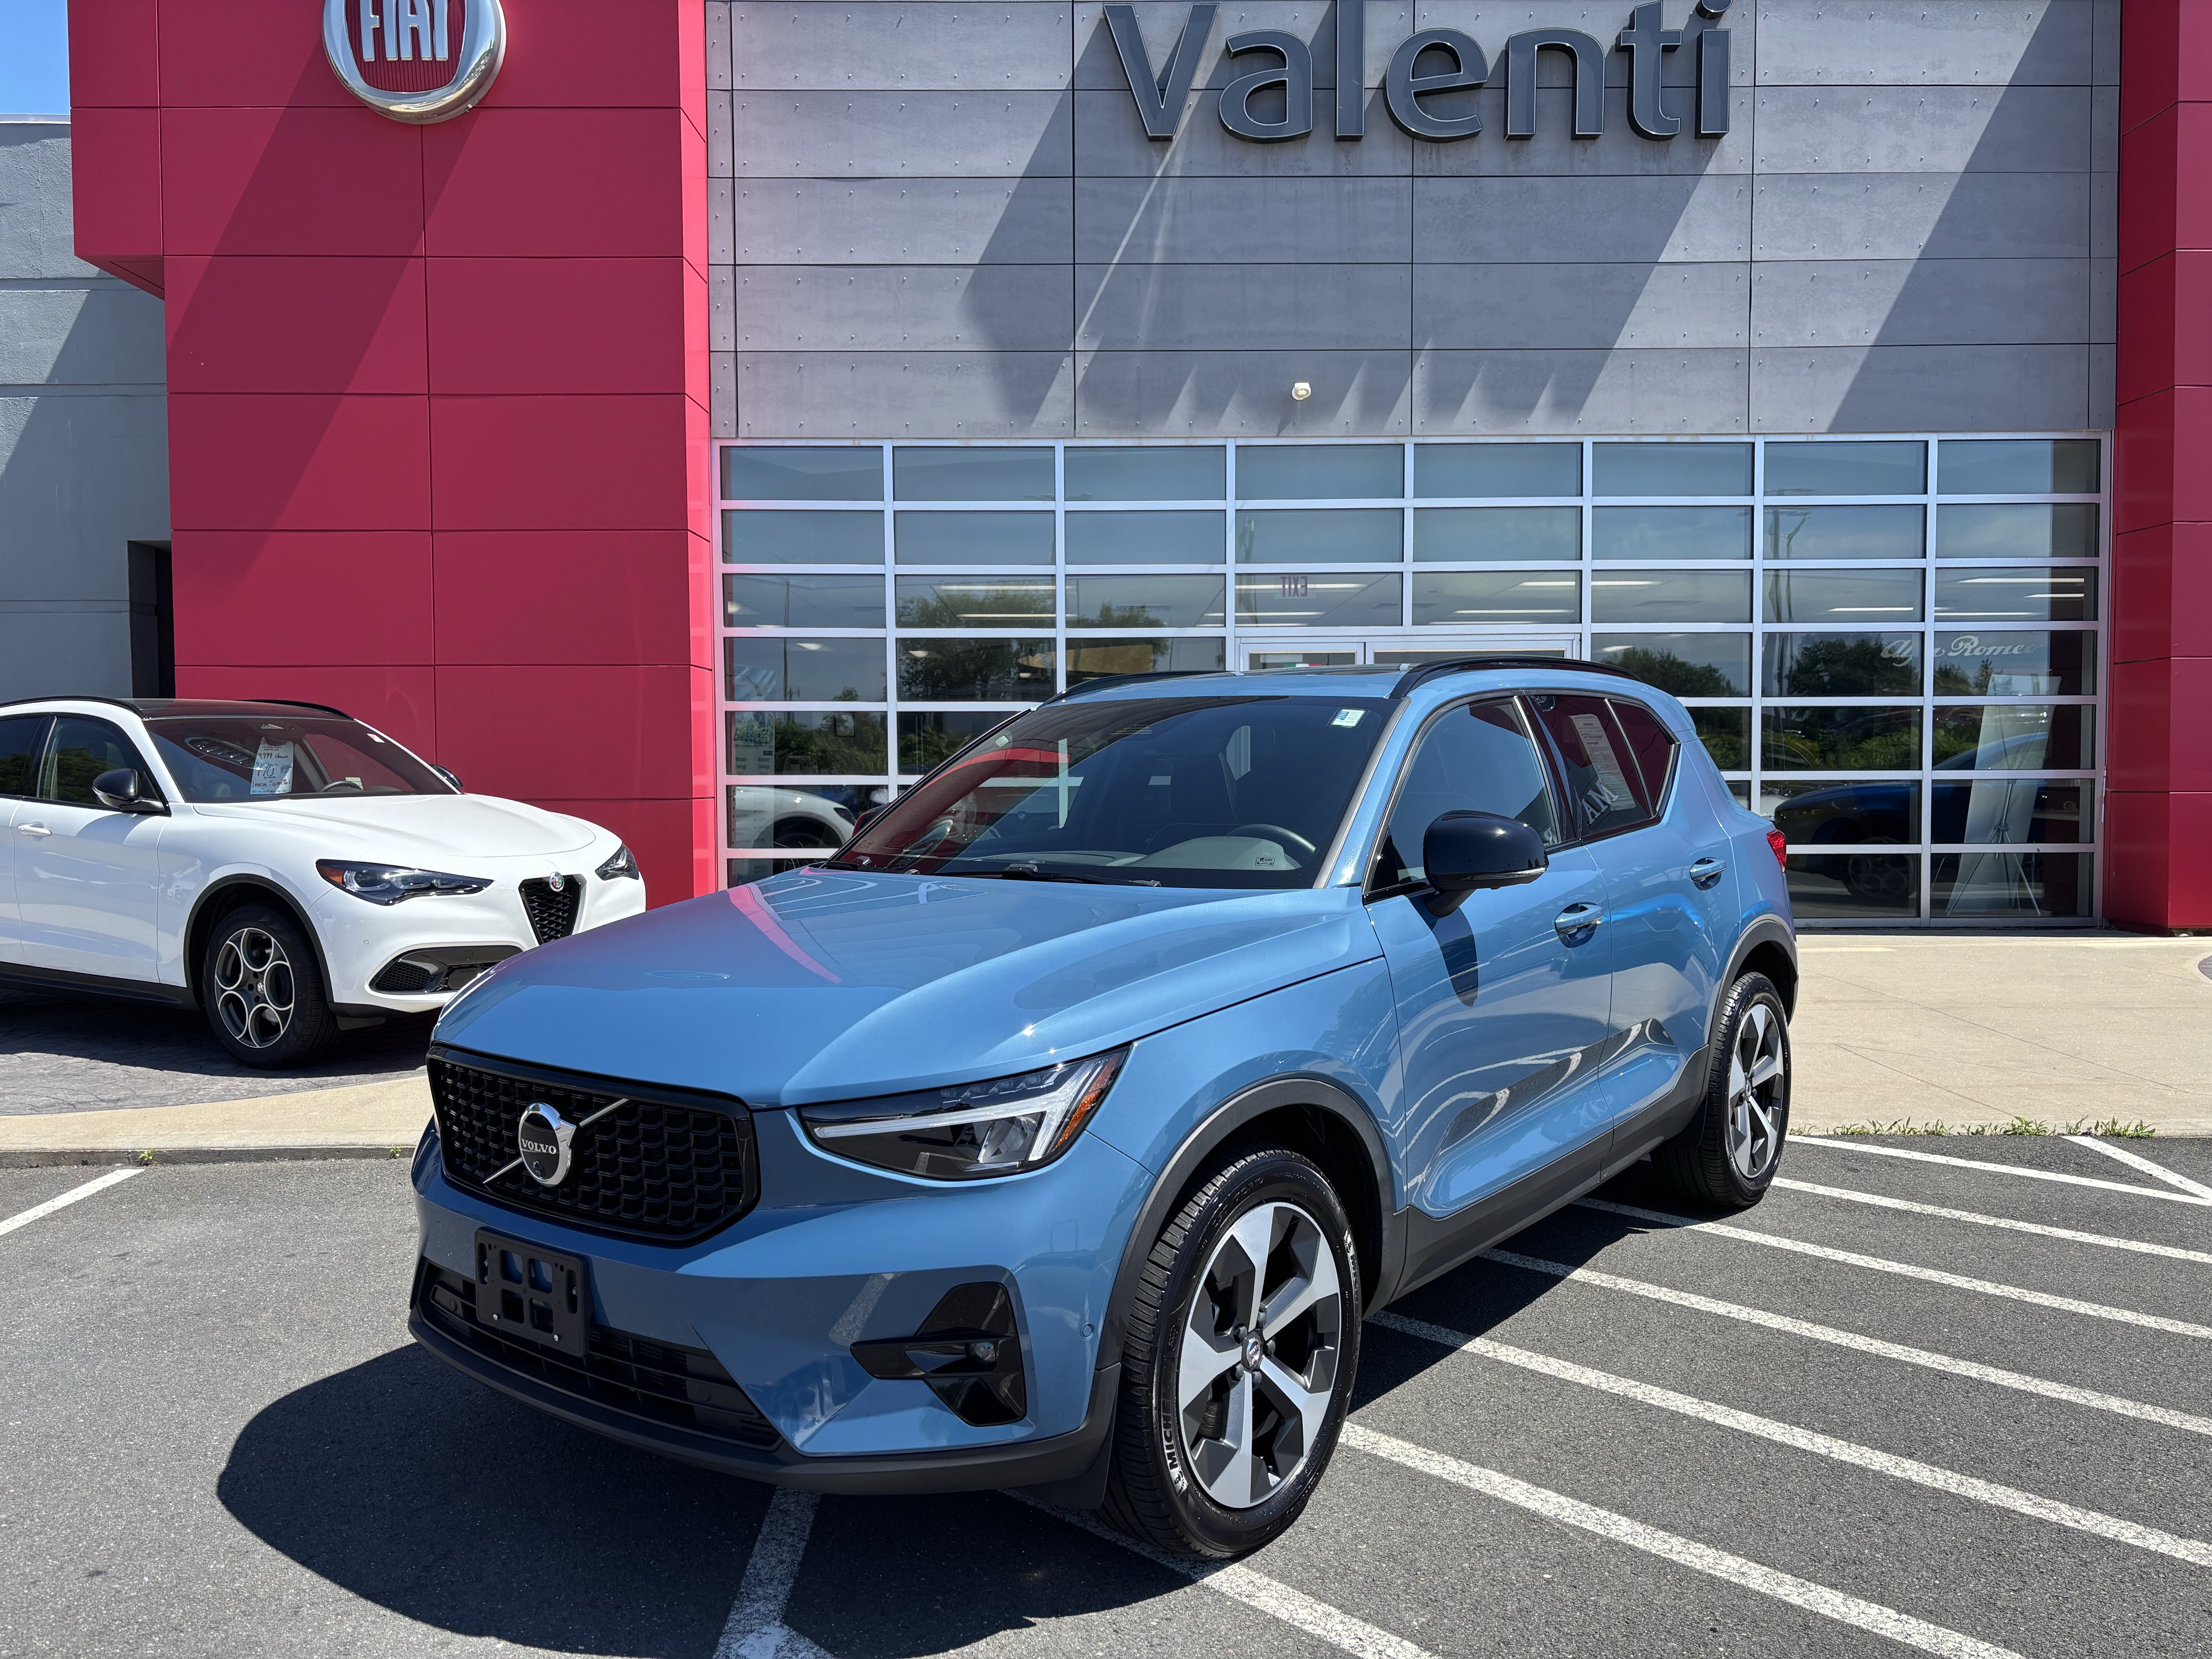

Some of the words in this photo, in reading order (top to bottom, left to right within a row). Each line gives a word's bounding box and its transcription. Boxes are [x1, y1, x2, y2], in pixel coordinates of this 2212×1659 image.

[361, 0, 448, 62] FIAT
[1103, 0, 1733, 143] Valenti
[1947, 634, 2042, 657] Romeo
[269, 779, 290, 787] Special
[521, 1138, 557, 1154] VOLVO
[1162, 1393, 1179, 1470] MICHE
